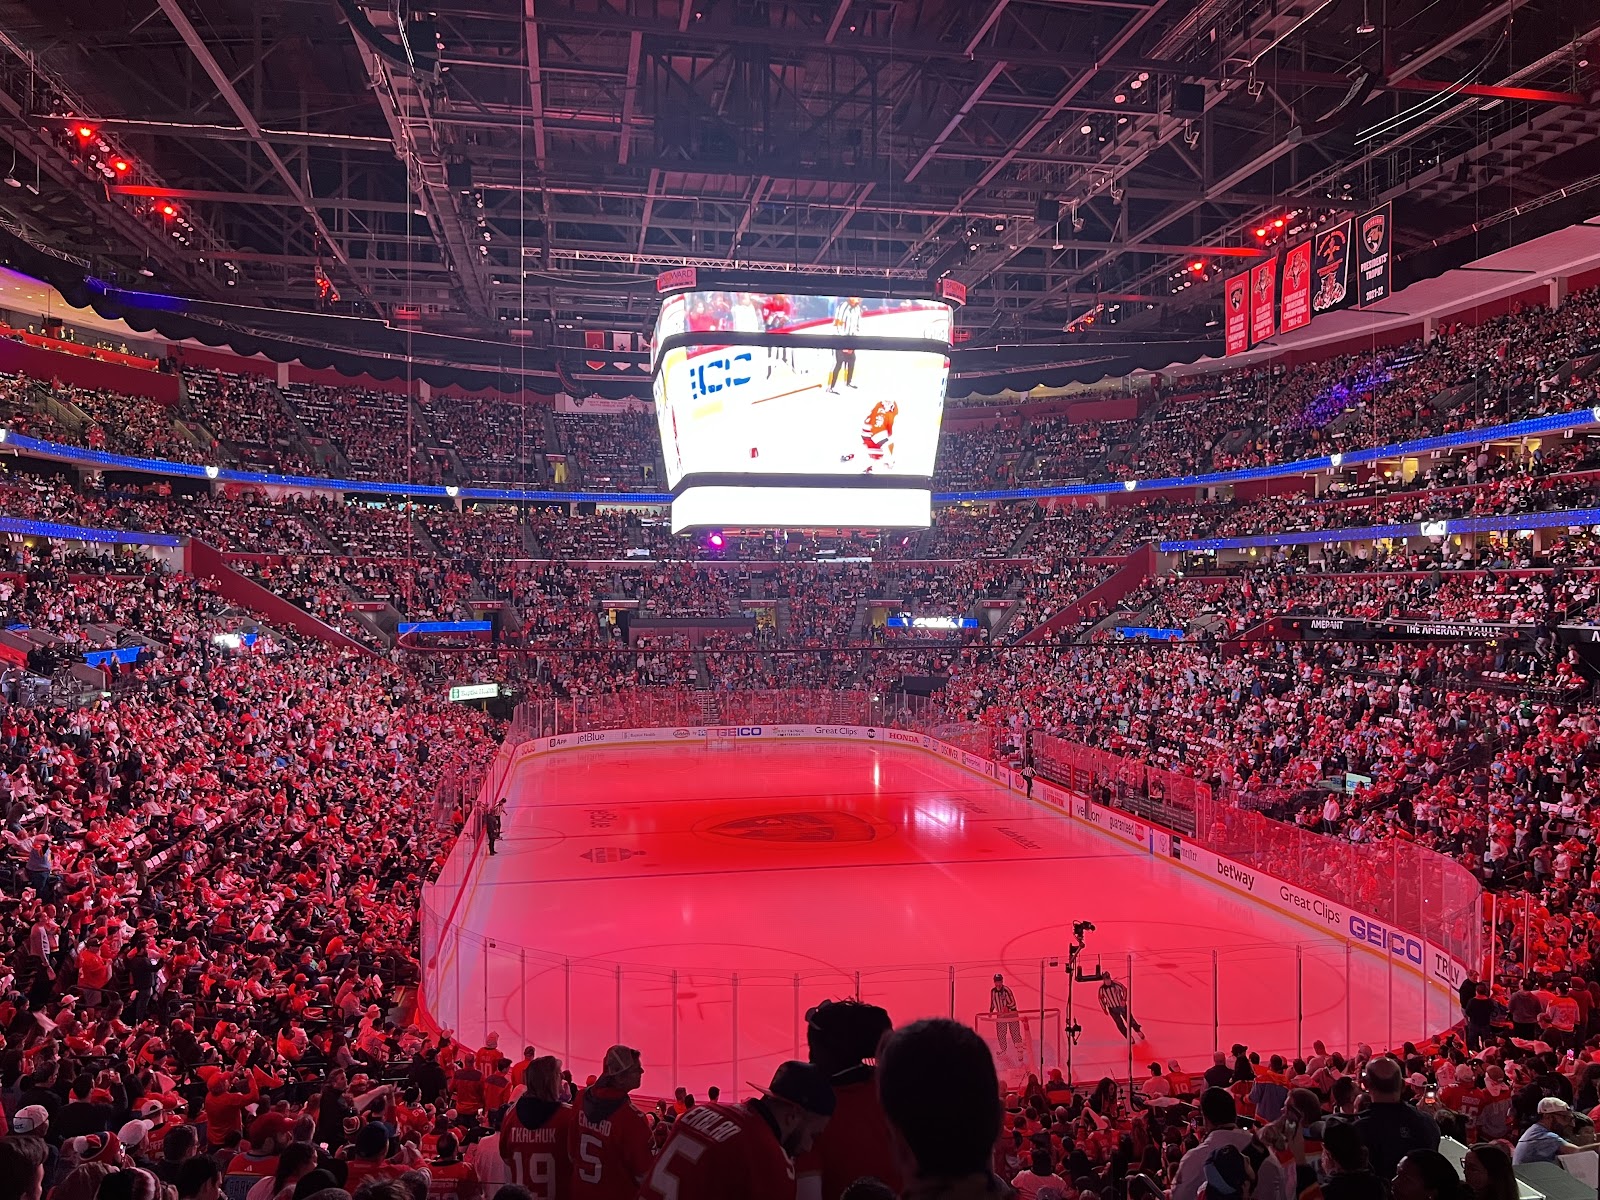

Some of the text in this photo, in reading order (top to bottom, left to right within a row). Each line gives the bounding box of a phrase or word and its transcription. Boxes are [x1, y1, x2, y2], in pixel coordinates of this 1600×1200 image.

[1311, 620, 1343, 630] AMERANT
[1406, 625, 1501, 638] THE AMERANT VAULT
[577, 732, 605, 745] jetBlue
[716, 727, 761, 737] GEICO
[814, 726, 858, 736] Great Clips
[889, 732, 919, 744] HONDA
[1217, 858, 1255, 891] betway
[1280, 885, 1341, 924] Great Clips
[1349, 915, 1422, 965] GEICO
[681, 1105, 742, 1143] EKBLAD
[511, 1126, 557, 1143] TKACHUK
[579, 1133, 603, 1185] 5
[512, 1151, 557, 1200] 19
